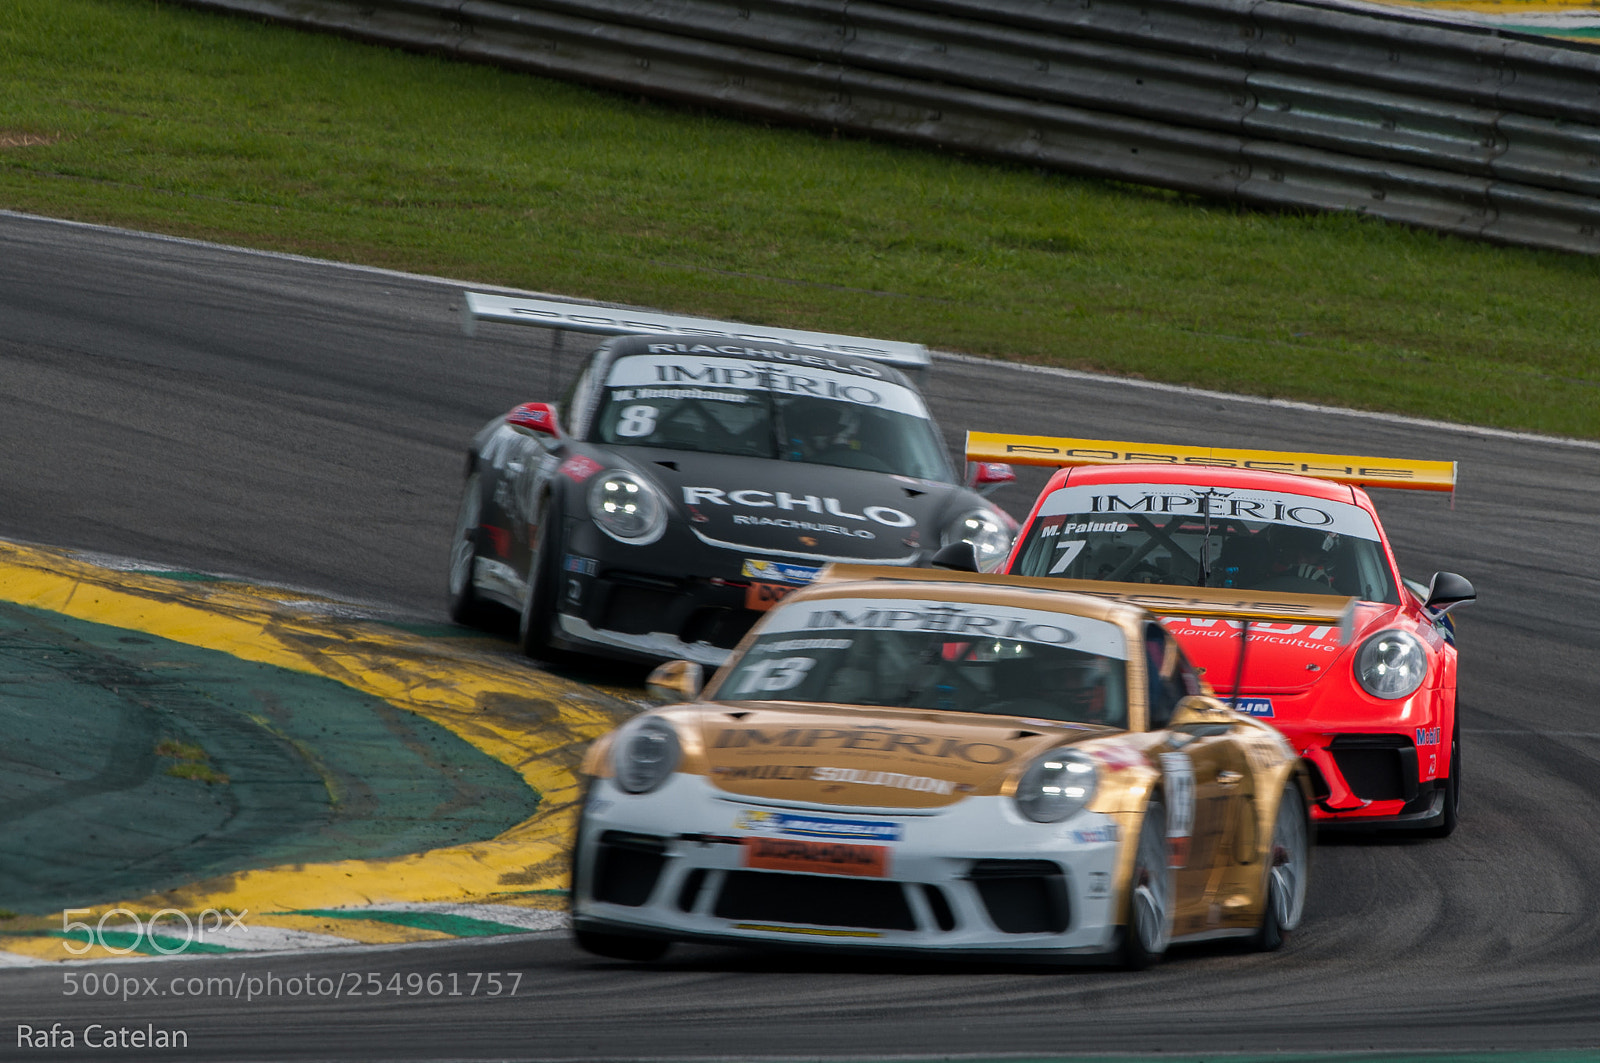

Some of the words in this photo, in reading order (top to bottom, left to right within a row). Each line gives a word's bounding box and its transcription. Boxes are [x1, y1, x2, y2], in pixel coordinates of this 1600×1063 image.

[648, 344, 882, 378] RIACHUELO
[616, 405, 659, 437] 8
[1006, 444, 1414, 478] PORSCHE
[681, 486, 917, 528] RCHLO
[733, 515, 876, 539] RIACHUELO
[1041, 526, 1061, 538] M.
[1065, 521, 1129, 536] Paludo
[1048, 540, 1086, 574] 7
[1168, 627, 1226, 638] sional
[1230, 630, 1336, 652] Agriculture
[734, 657, 817, 693] 13
